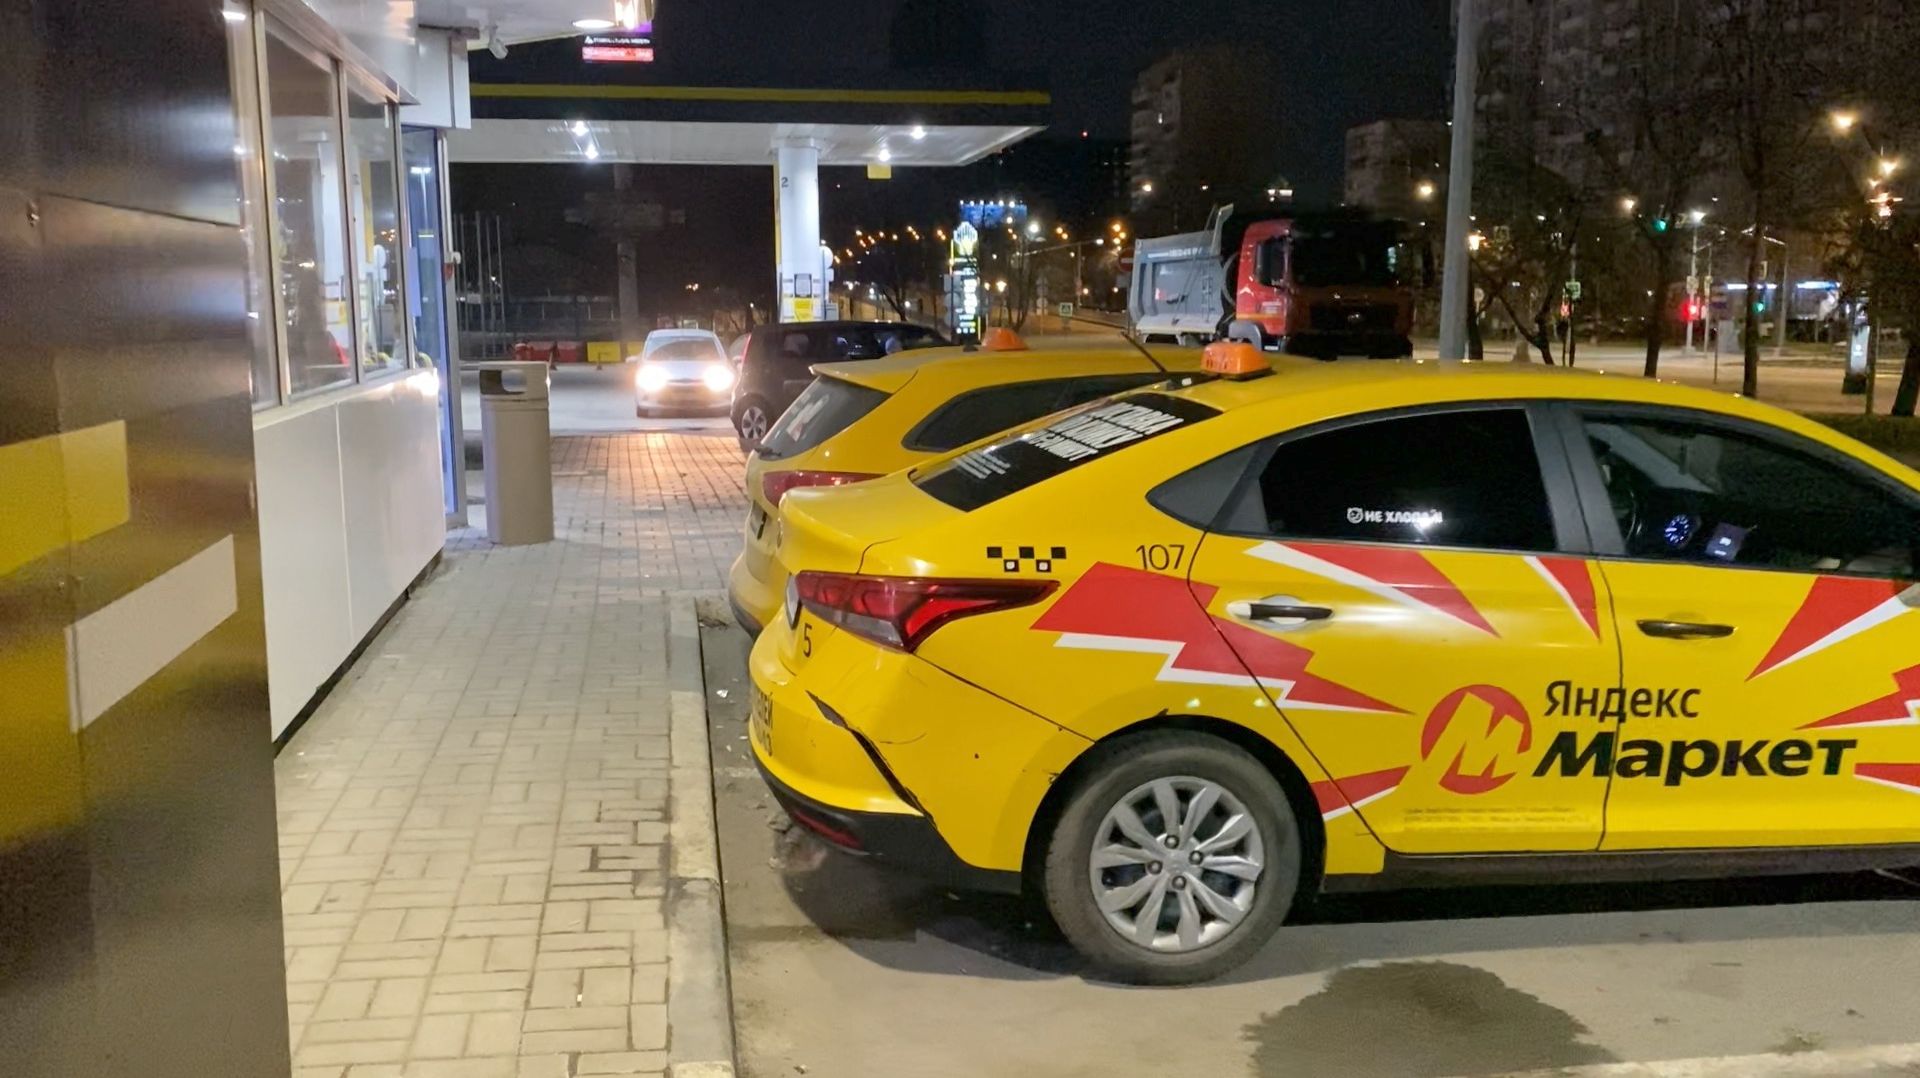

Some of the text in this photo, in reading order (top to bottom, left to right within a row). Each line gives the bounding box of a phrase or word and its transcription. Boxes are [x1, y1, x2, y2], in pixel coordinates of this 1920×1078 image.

[781, 176, 789, 187] 2
[1365, 511, 1383, 523] НЕ
[1136, 544, 1185, 570] 107
[803, 623, 812, 657] 5
[1544, 680, 1701, 723] Яндекс
[1532, 731, 1857, 786] Маркет
